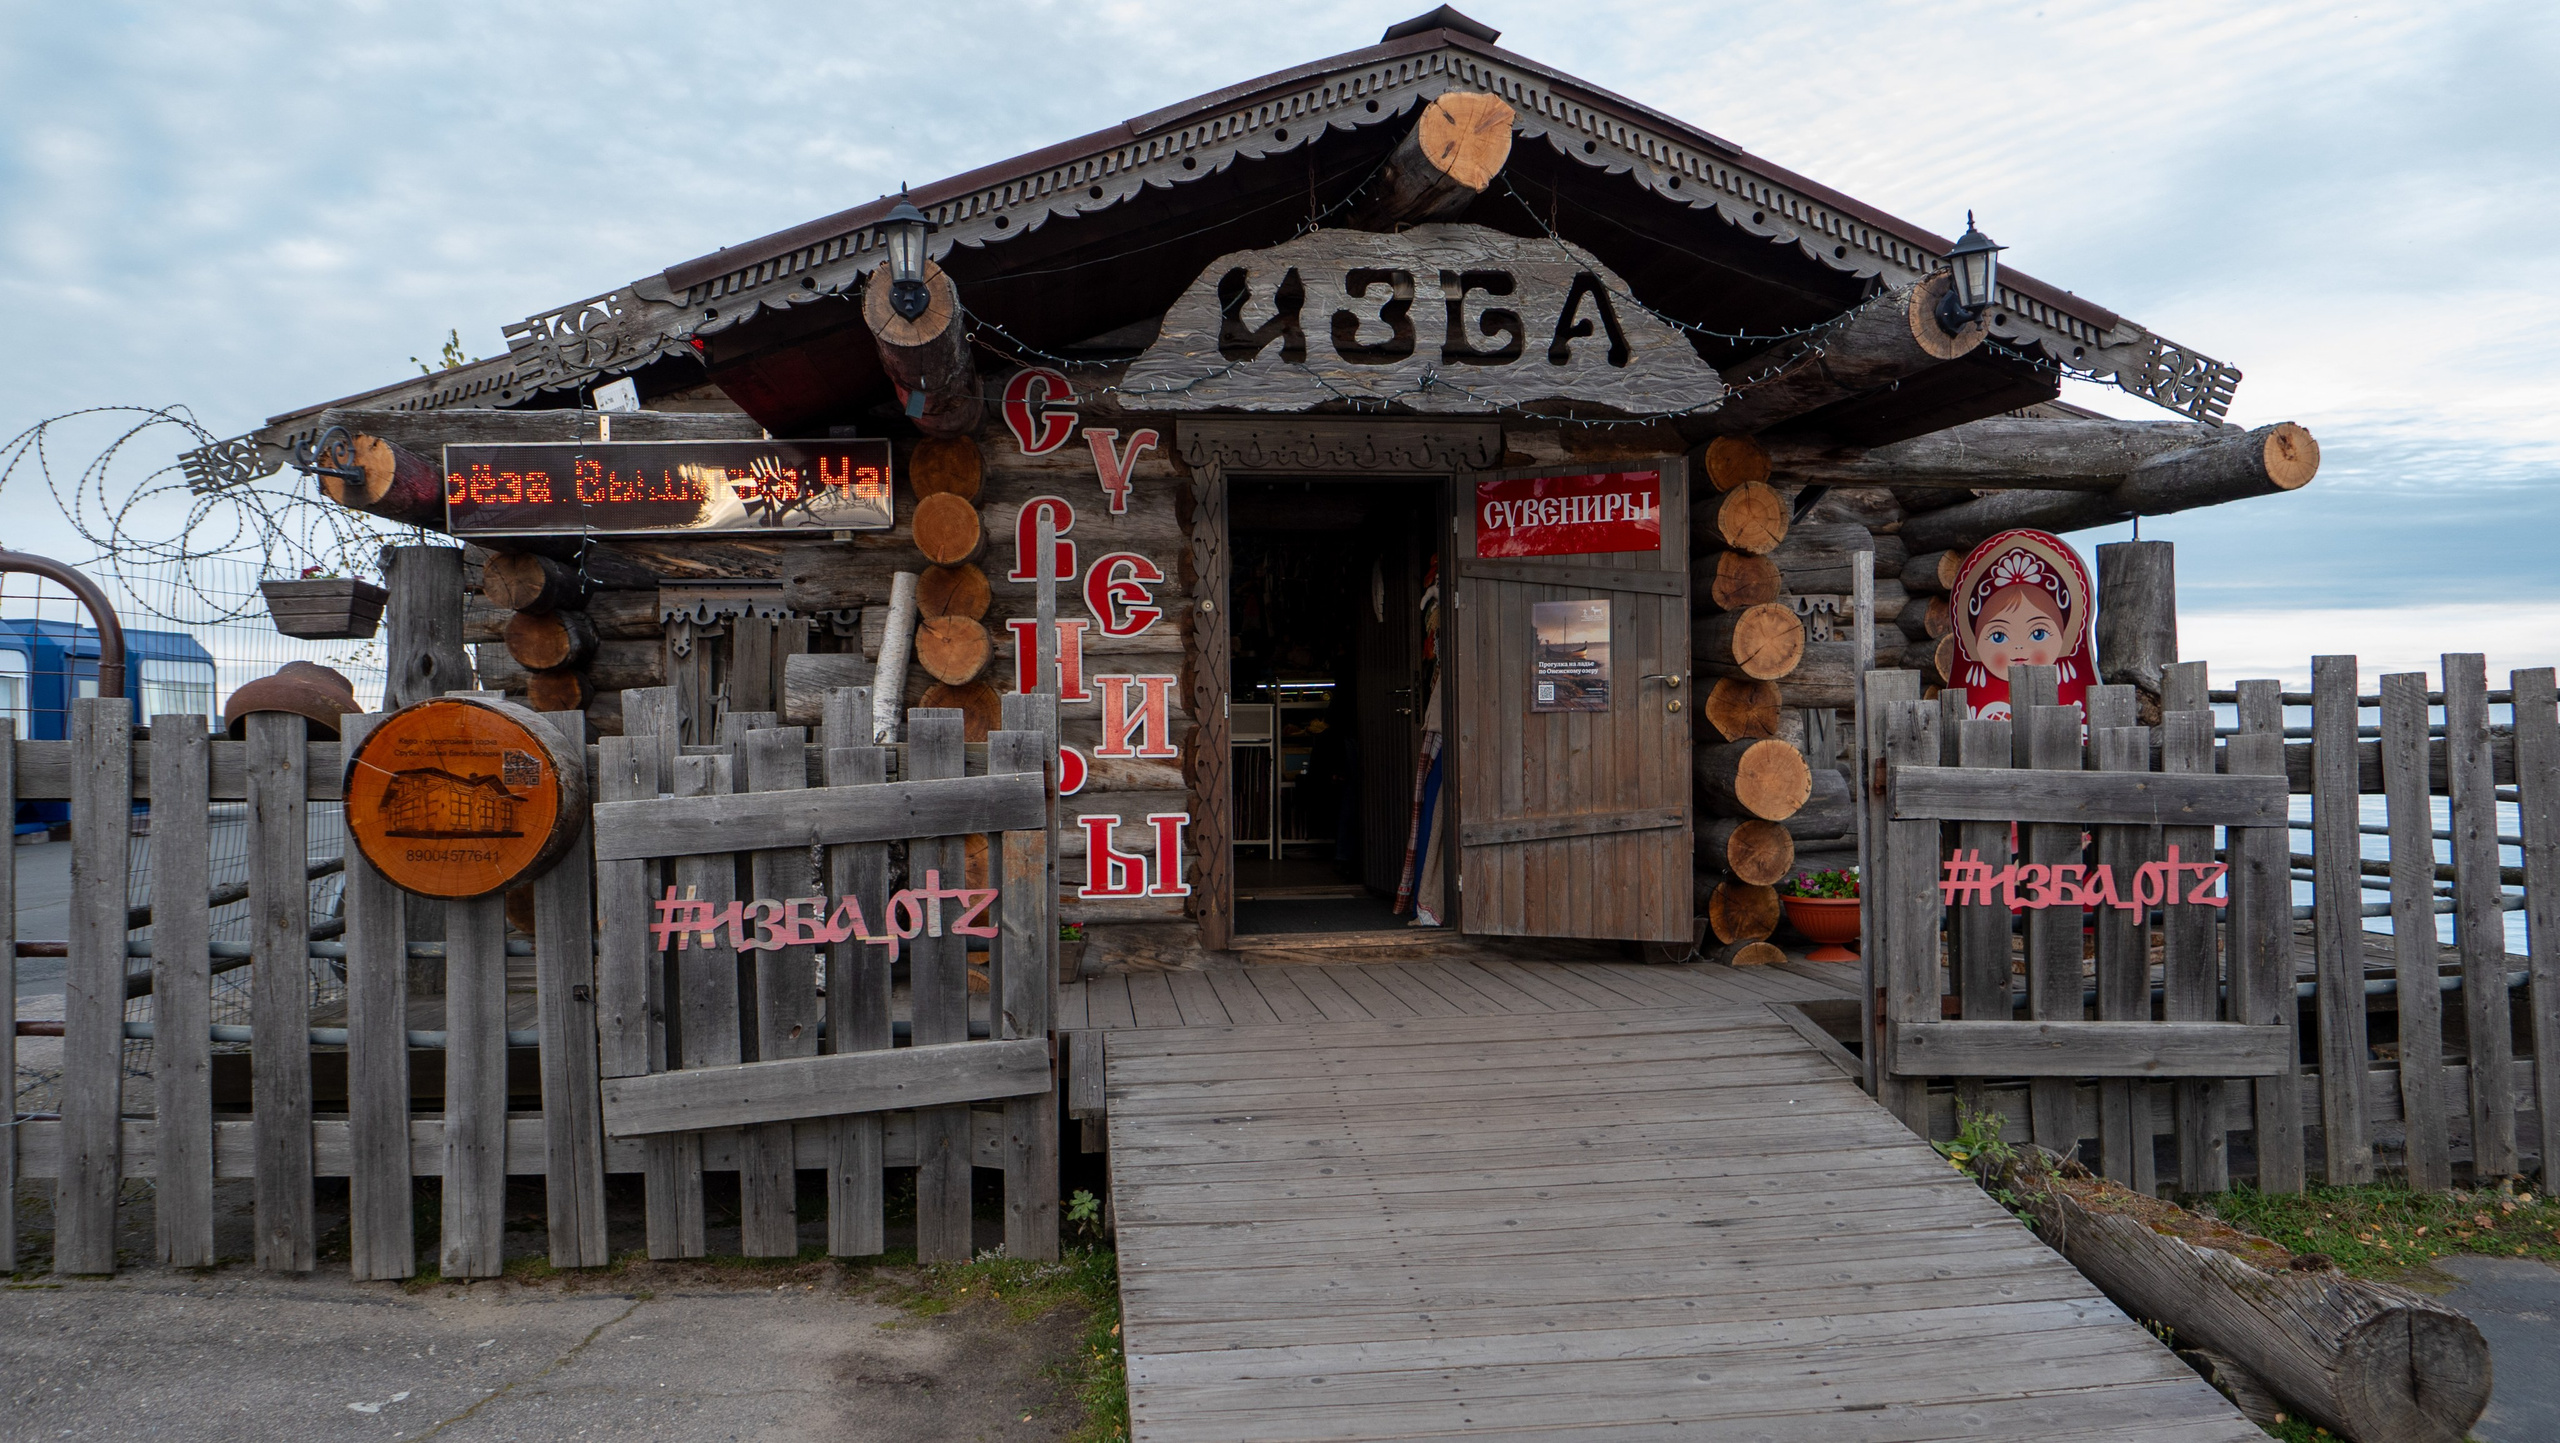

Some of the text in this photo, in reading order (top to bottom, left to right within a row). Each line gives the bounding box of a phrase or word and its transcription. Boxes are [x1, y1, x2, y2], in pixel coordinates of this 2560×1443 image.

[1217, 265, 1631, 368] ИЗБА
[820, 456, 890, 499] Ча
[1483, 491, 1652, 537] СУВЕНИРЫ
[406, 850, 499, 862] 89004577641
